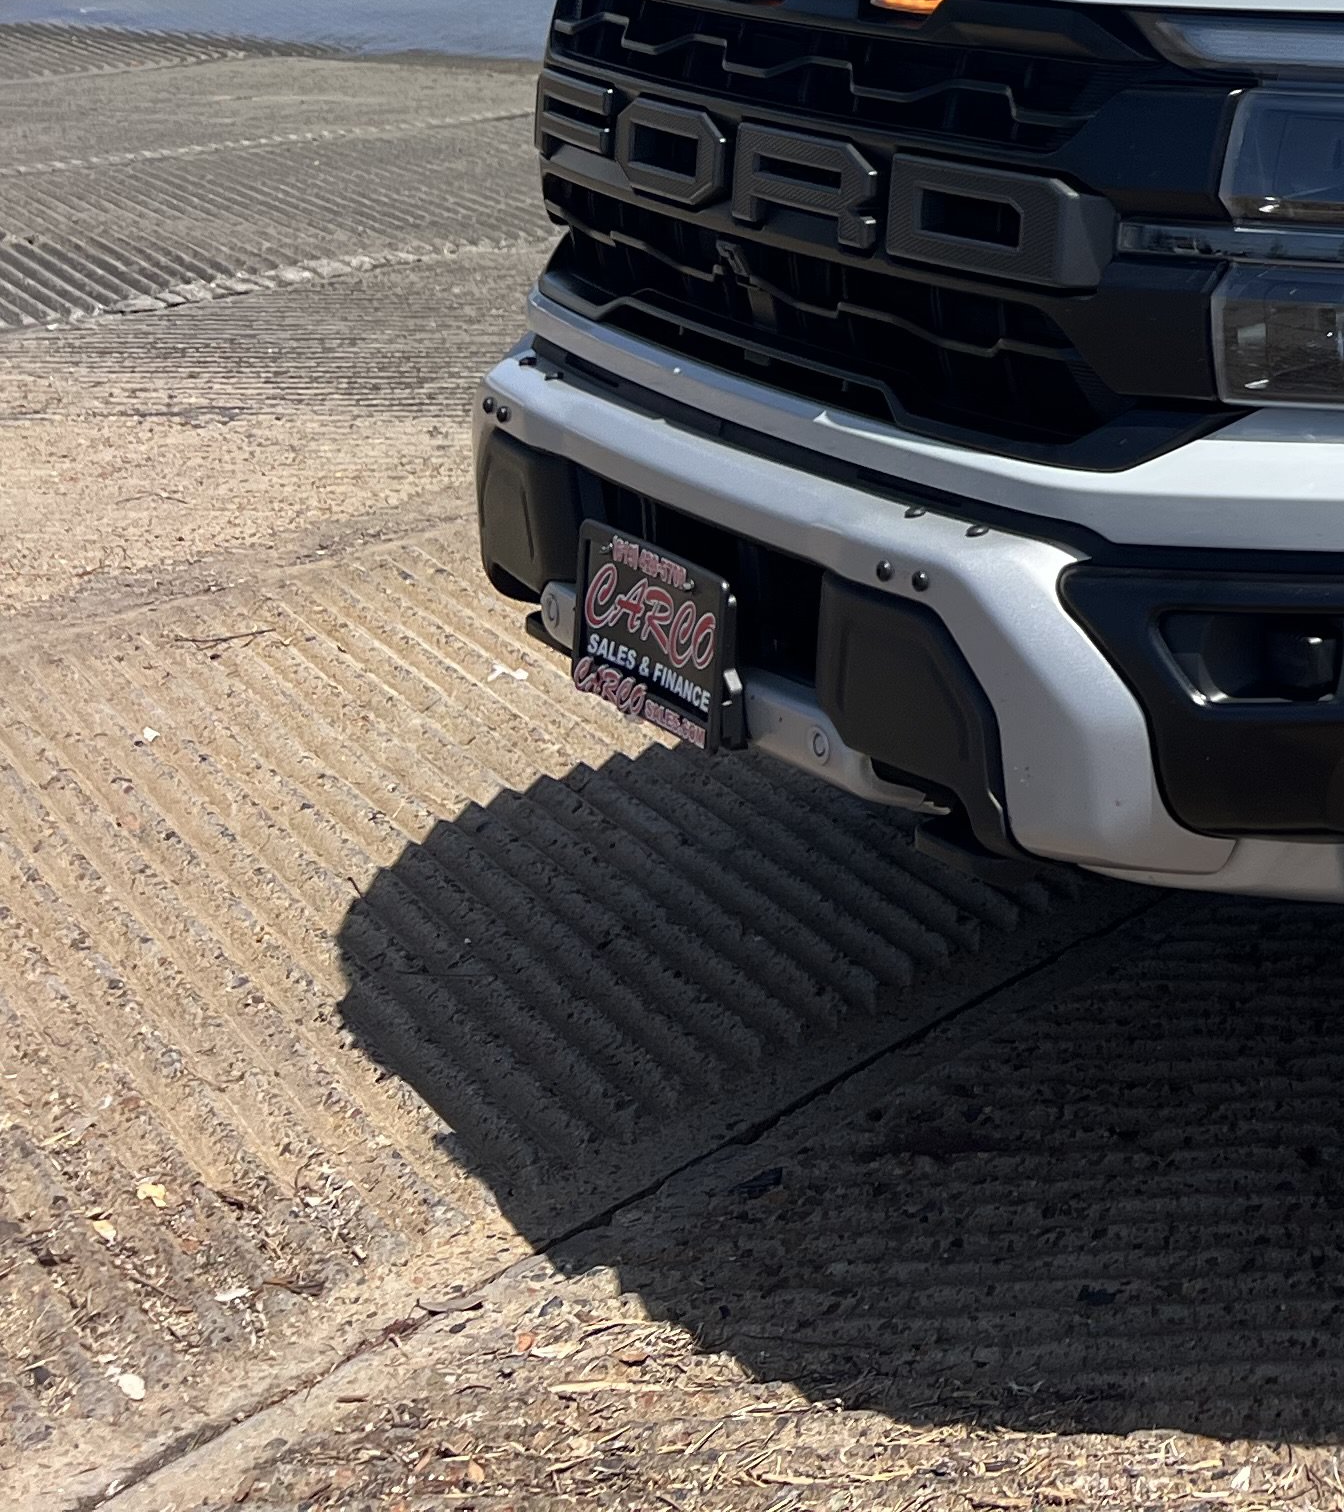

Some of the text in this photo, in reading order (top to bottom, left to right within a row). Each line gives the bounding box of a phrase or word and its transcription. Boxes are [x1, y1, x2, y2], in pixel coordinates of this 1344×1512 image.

[534, 69, 1118, 292] FORD
[585, 562, 716, 671] CARCO
[574, 656, 648, 716] CARCO
[587, 632, 711, 713] SALES & FINANCE
